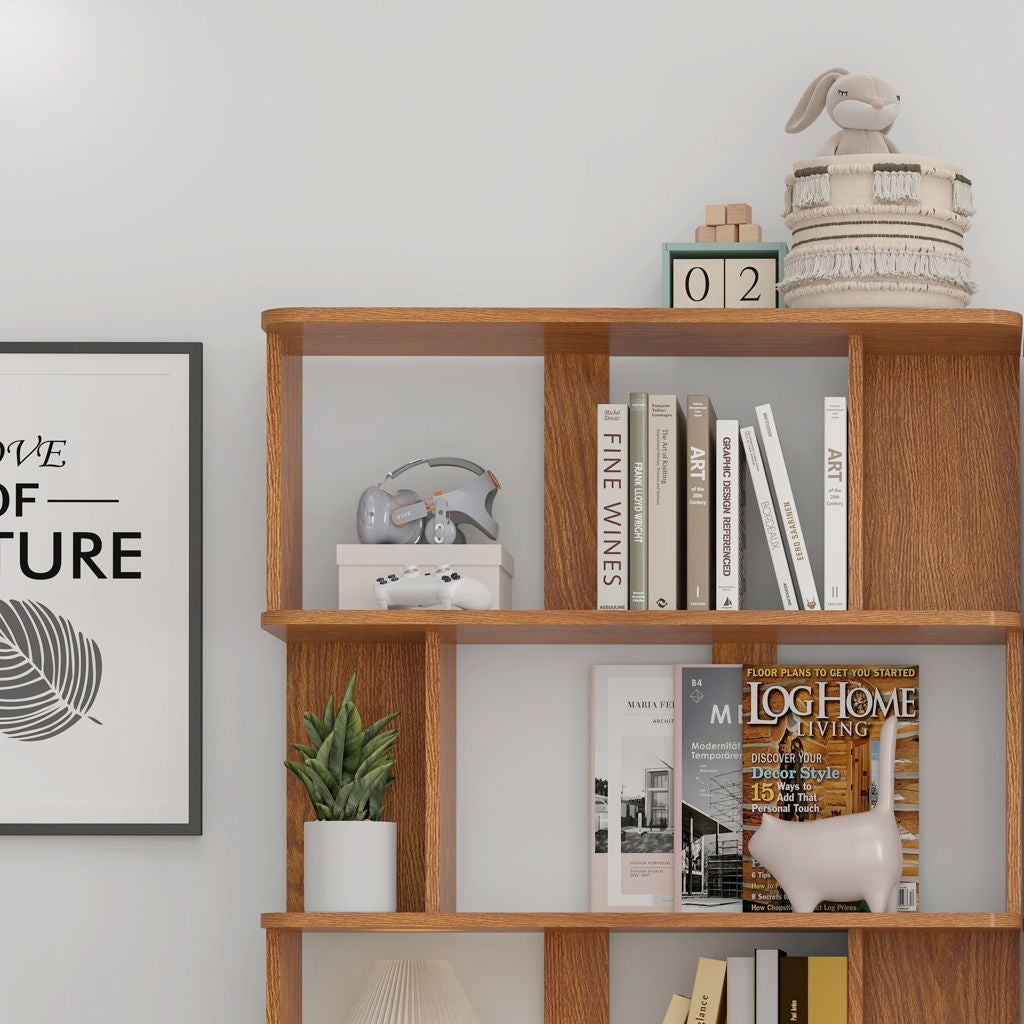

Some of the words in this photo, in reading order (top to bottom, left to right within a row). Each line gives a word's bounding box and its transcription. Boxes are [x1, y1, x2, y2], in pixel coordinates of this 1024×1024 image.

[0, 435, 66, 467] VE
[603, 434, 621, 489] FINE
[690, 446, 706, 480] ART
[722, 436, 731, 478] GRAPHIC
[634, 462, 643, 486] FRANK
[827, 448, 842, 482] ART
[0, 483, 39, 517] F
[634, 488, 643, 512] LLOYD
[722, 481, 731, 514] DESIGN
[634, 513, 643, 543] WRIGHT
[761, 501, 779, 550] BORDEAUX
[783, 501, 799, 540] SAARINEN
[603, 502, 621, 586] WINES
[722, 517, 731, 577] REFERENCED
[793, 541, 804, 561] EERO
[747, 668, 778, 677] FLOOR
[780, 668, 811, 677] PLANS
[815, 668, 827, 677] TO
[829, 668, 848, 677] GET
[852, 668, 870, 677] YOU
[873, 668, 915, 677] STARTED
[798, 721, 869, 737] LIVING
[691, 742, 740, 750] Modernität
[751, 753, 796, 763] DISCOVER
[798, 753, 822, 763] YOUR
[751, 767, 796, 779] Decor
[800, 766, 840, 782] Style
[777, 782, 800, 792] Ways
[802, 782, 812, 791] to
[751, 783, 775, 801] 15
[777, 793, 794, 802] Add
[798, 793, 817, 802] That
[751, 804, 790, 813] Personal
[794, 804, 820, 813] Touch
